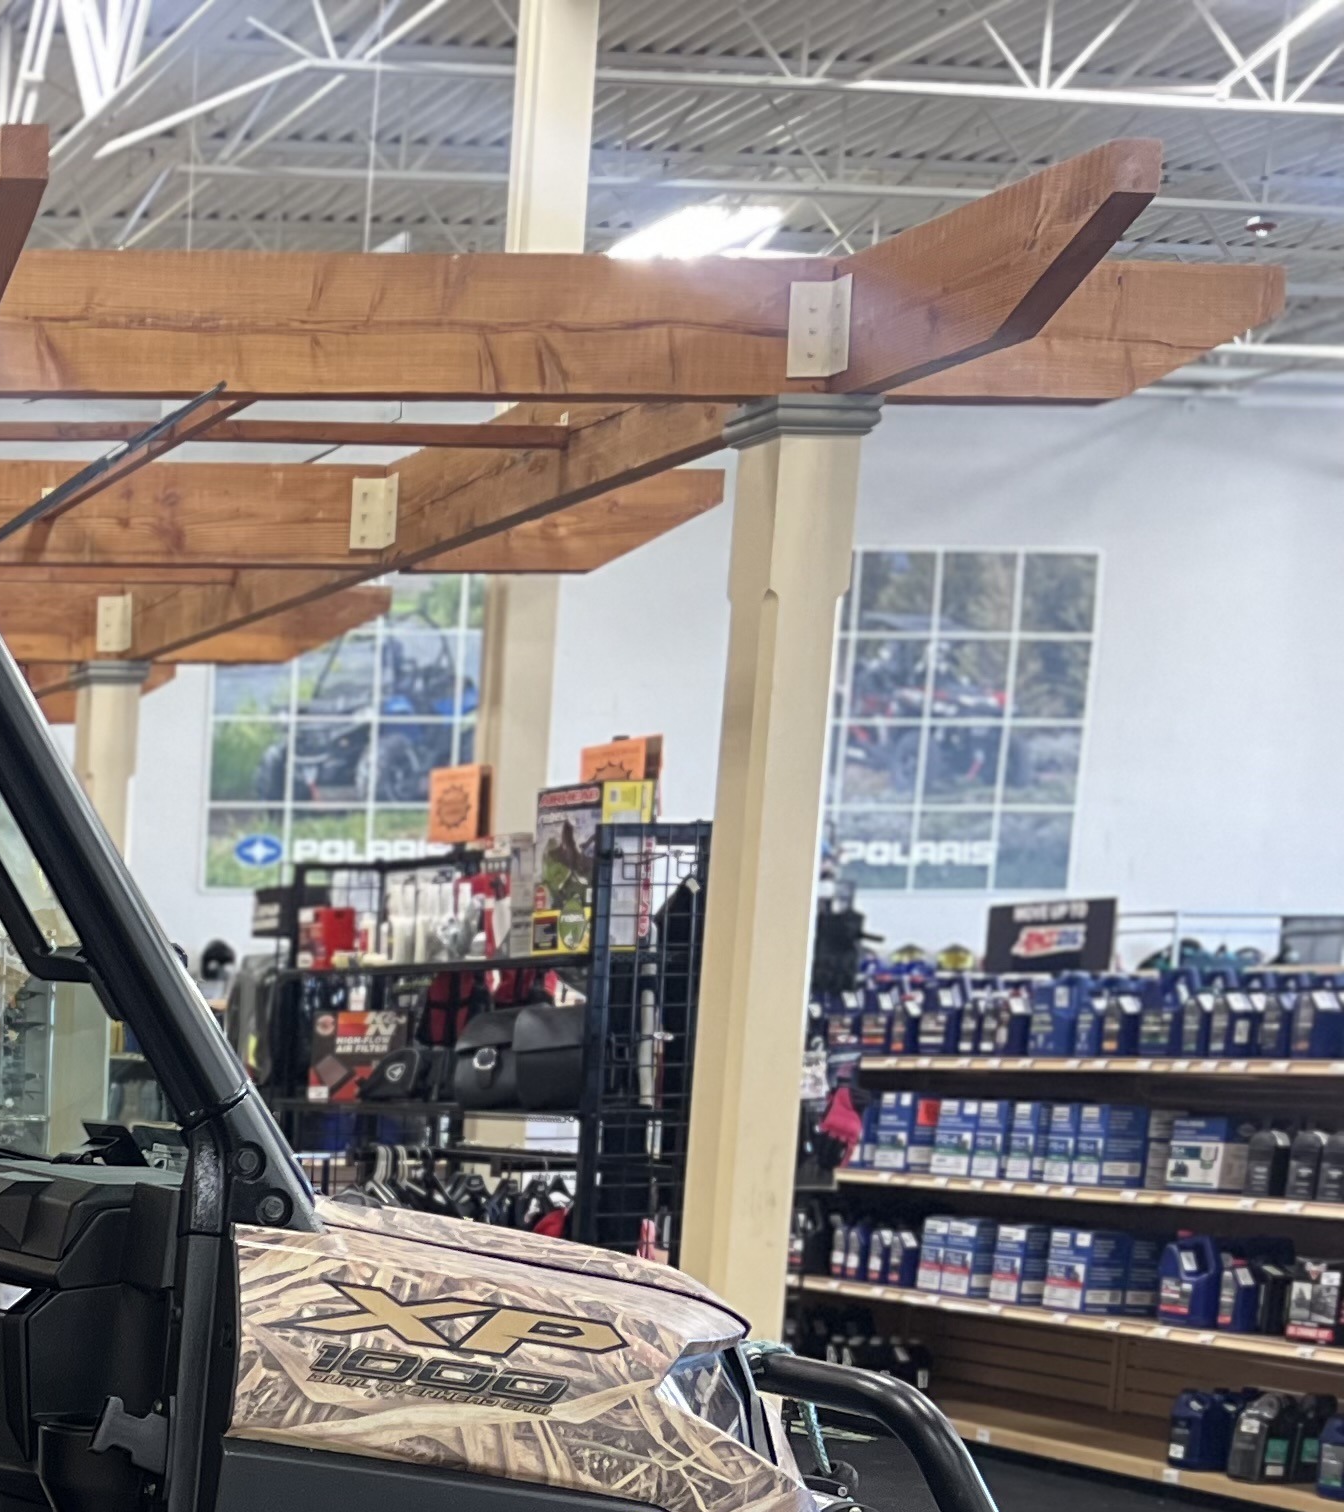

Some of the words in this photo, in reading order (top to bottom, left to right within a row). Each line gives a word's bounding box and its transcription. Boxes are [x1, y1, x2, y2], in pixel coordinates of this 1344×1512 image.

[539, 787, 600, 808] AIRHEAD
[840, 841, 995, 866] POLARIS
[336, 1036, 391, 1045] HIGH-FLOW
[336, 1044, 352, 1053] AIR
[355, 1044, 388, 1053] FILTER
[260, 1279, 630, 1355] XP
[308, 1341, 570, 1402] 1000
[306, 1373, 370, 1389] DUAL
[375, 1383, 499, 1408] OVERHEAD
[500, 1400, 553, 1416] CAM
